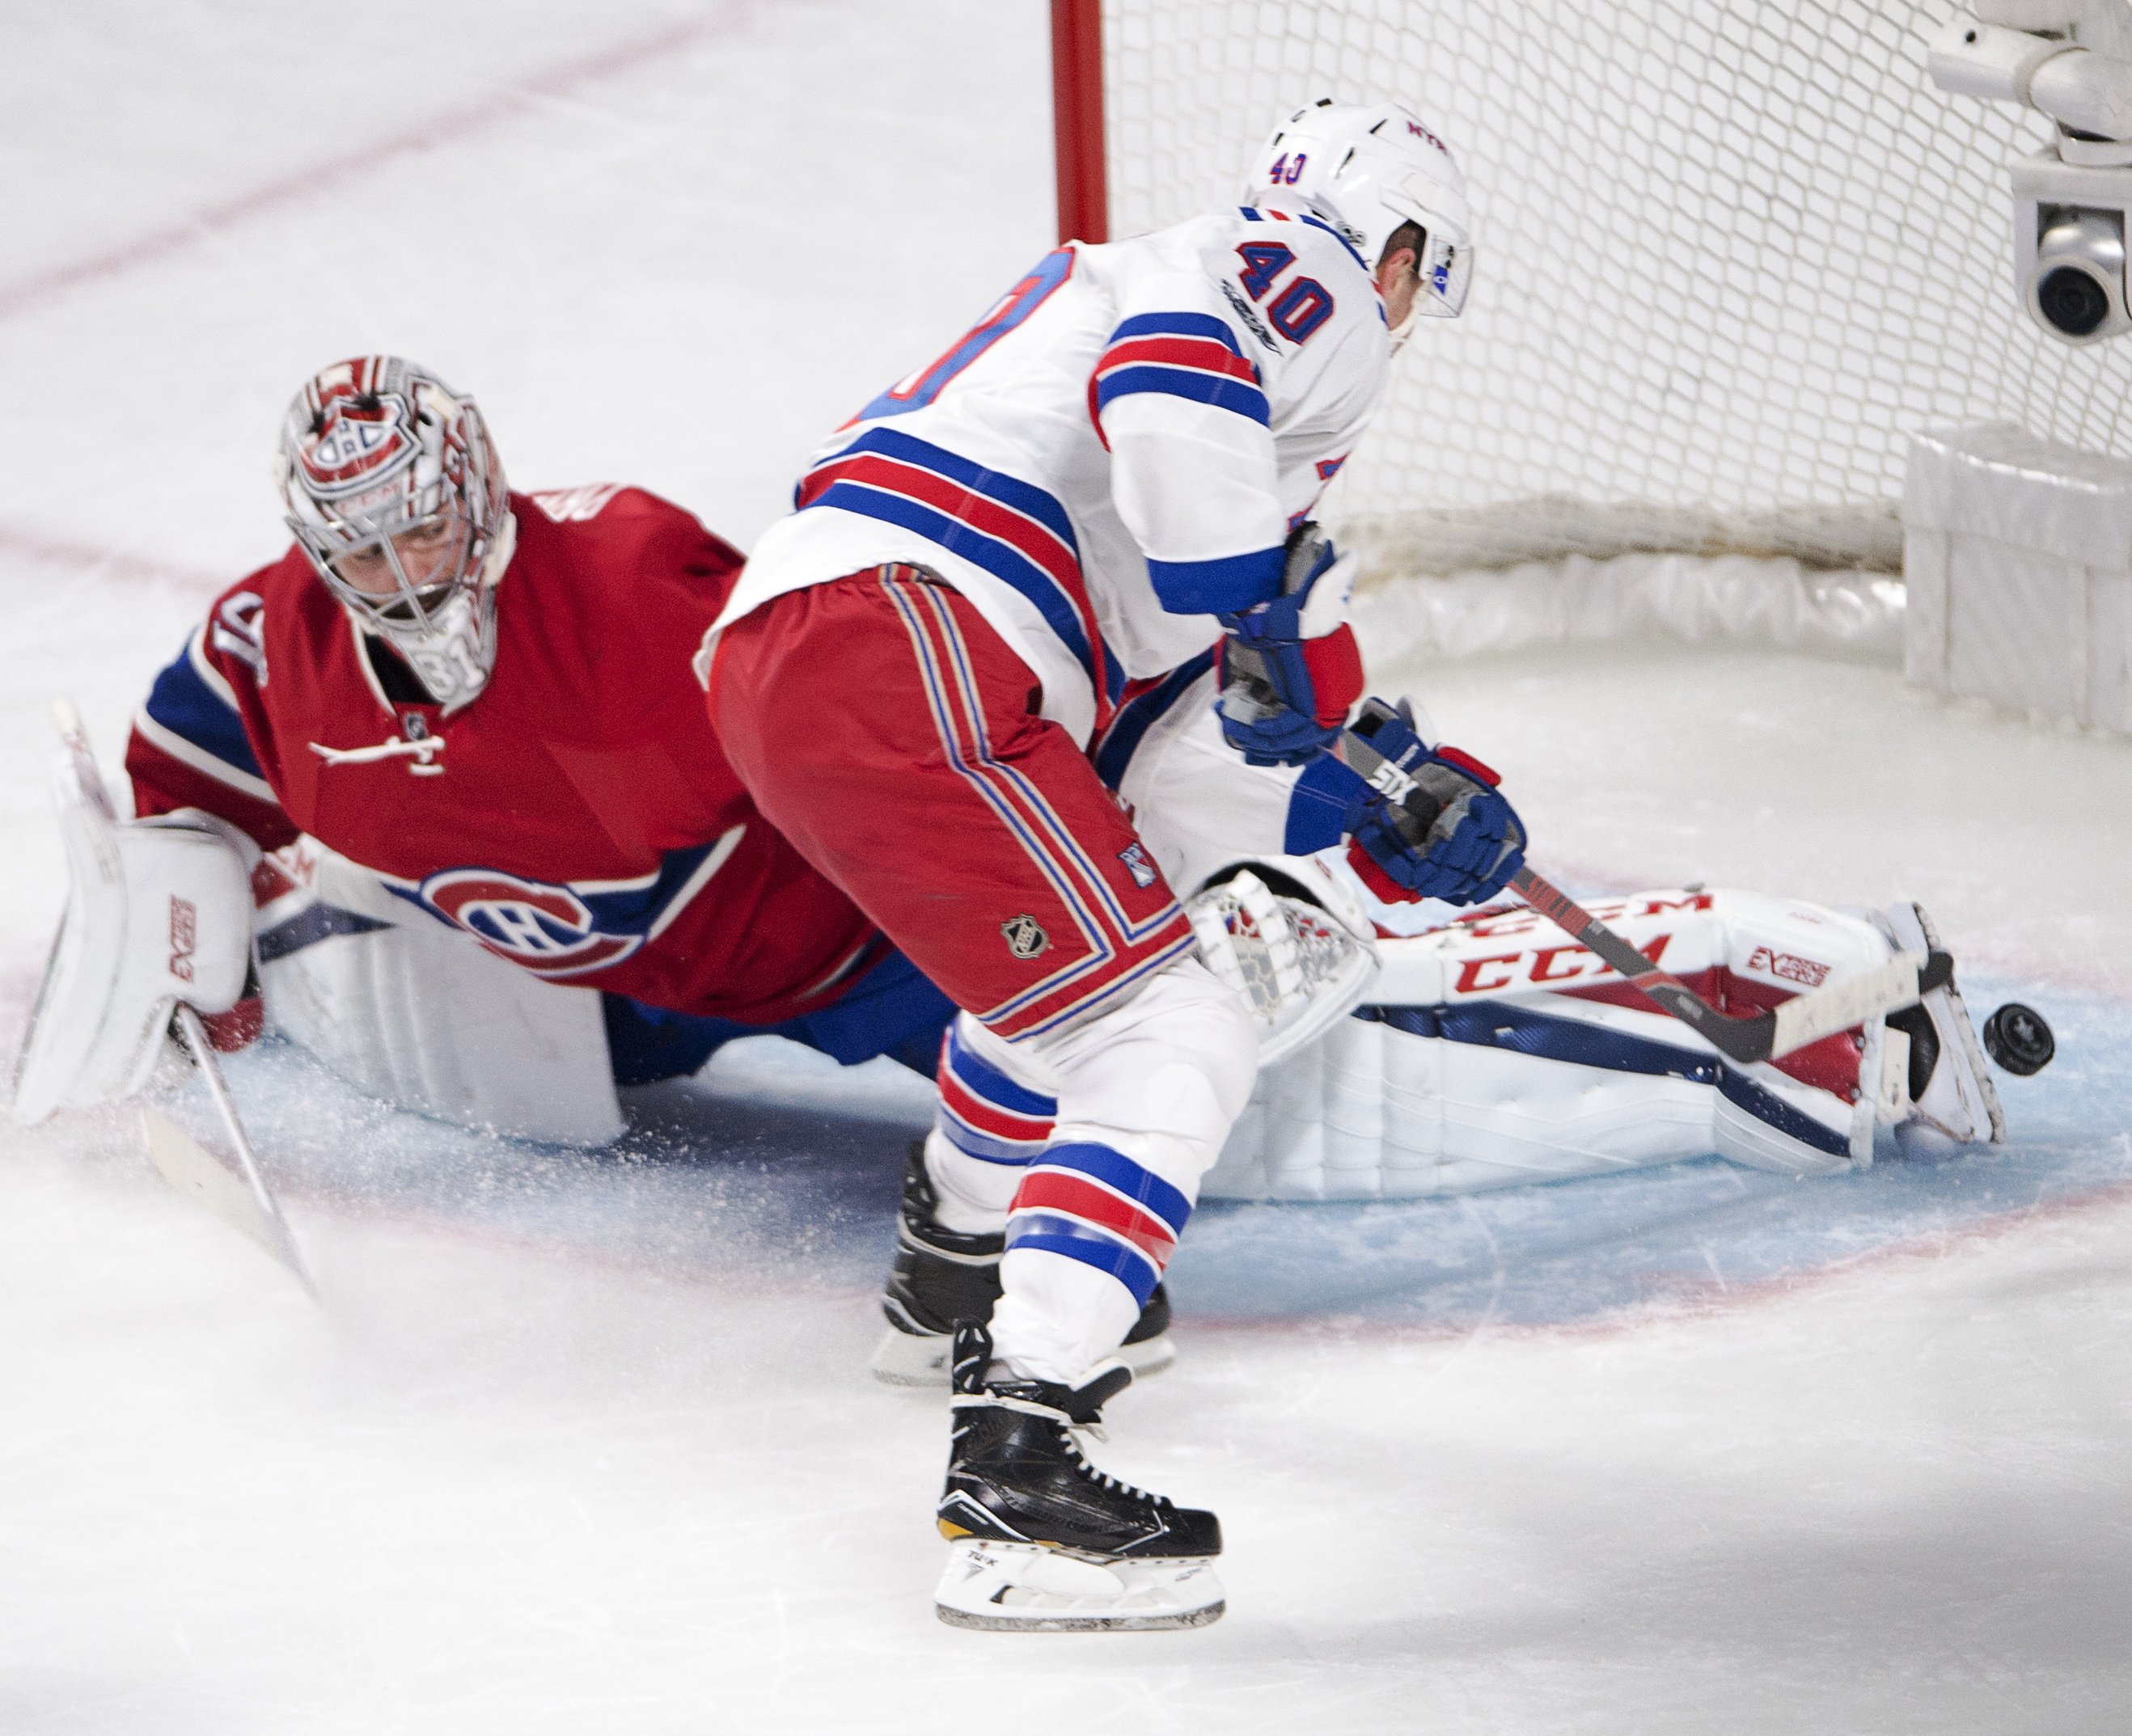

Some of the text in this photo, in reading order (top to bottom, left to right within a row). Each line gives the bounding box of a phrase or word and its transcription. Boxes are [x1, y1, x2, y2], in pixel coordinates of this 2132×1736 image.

[1269, 151, 1306, 185] 40
[1234, 240, 1335, 346] 40
[1365, 758, 1419, 806] STX
